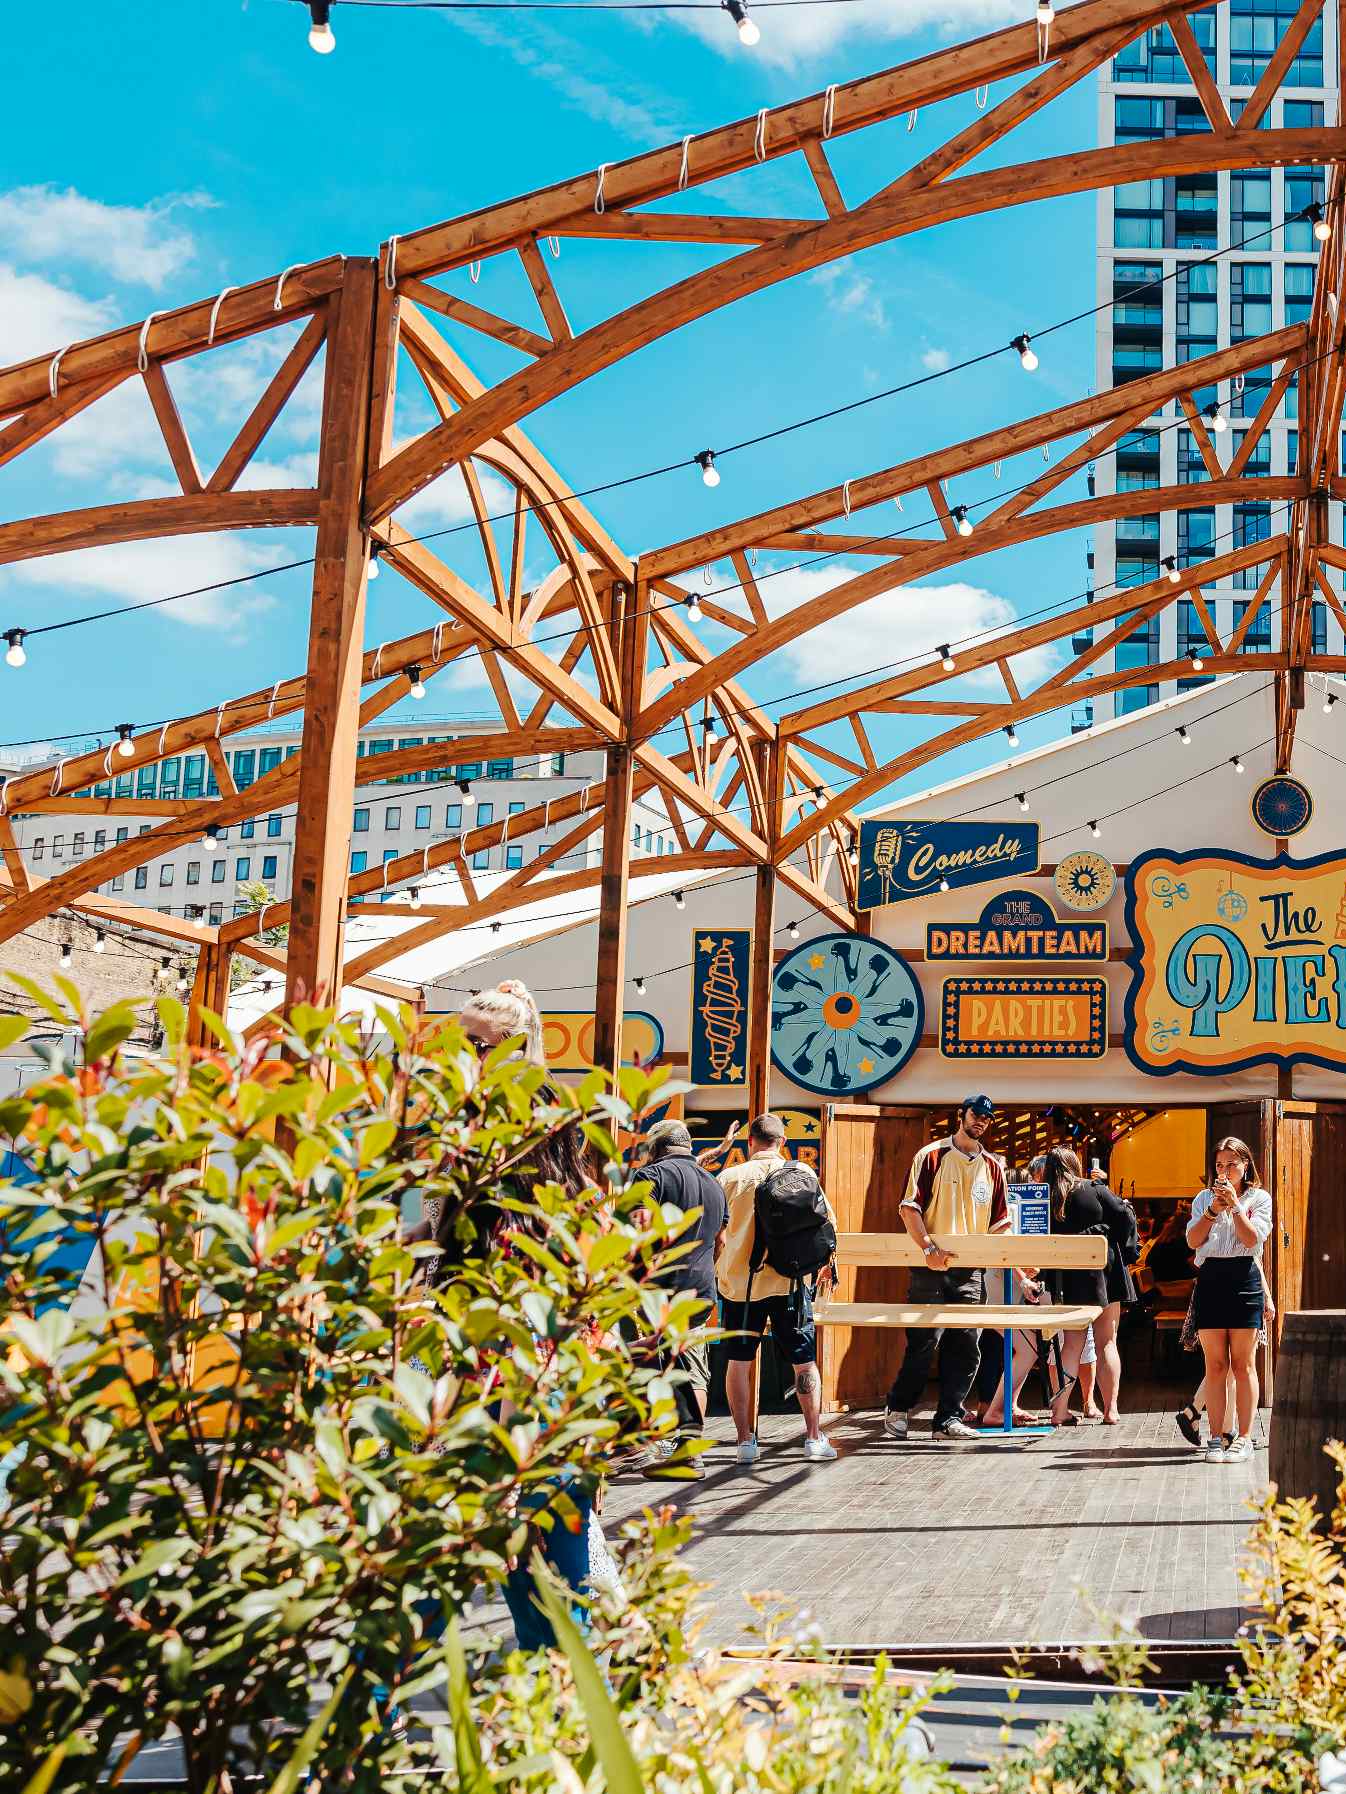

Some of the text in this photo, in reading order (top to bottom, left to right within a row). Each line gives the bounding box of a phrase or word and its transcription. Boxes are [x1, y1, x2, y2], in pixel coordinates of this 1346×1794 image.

[908, 833, 1021, 881] Comedy
[991, 913, 1043, 926] GRAND
[1004, 901, 1031, 914] THE
[1259, 892, 1322, 942] The
[931, 930, 1103, 956] DREAMTEAM
[971, 999, 1077, 1037] PARTIES
